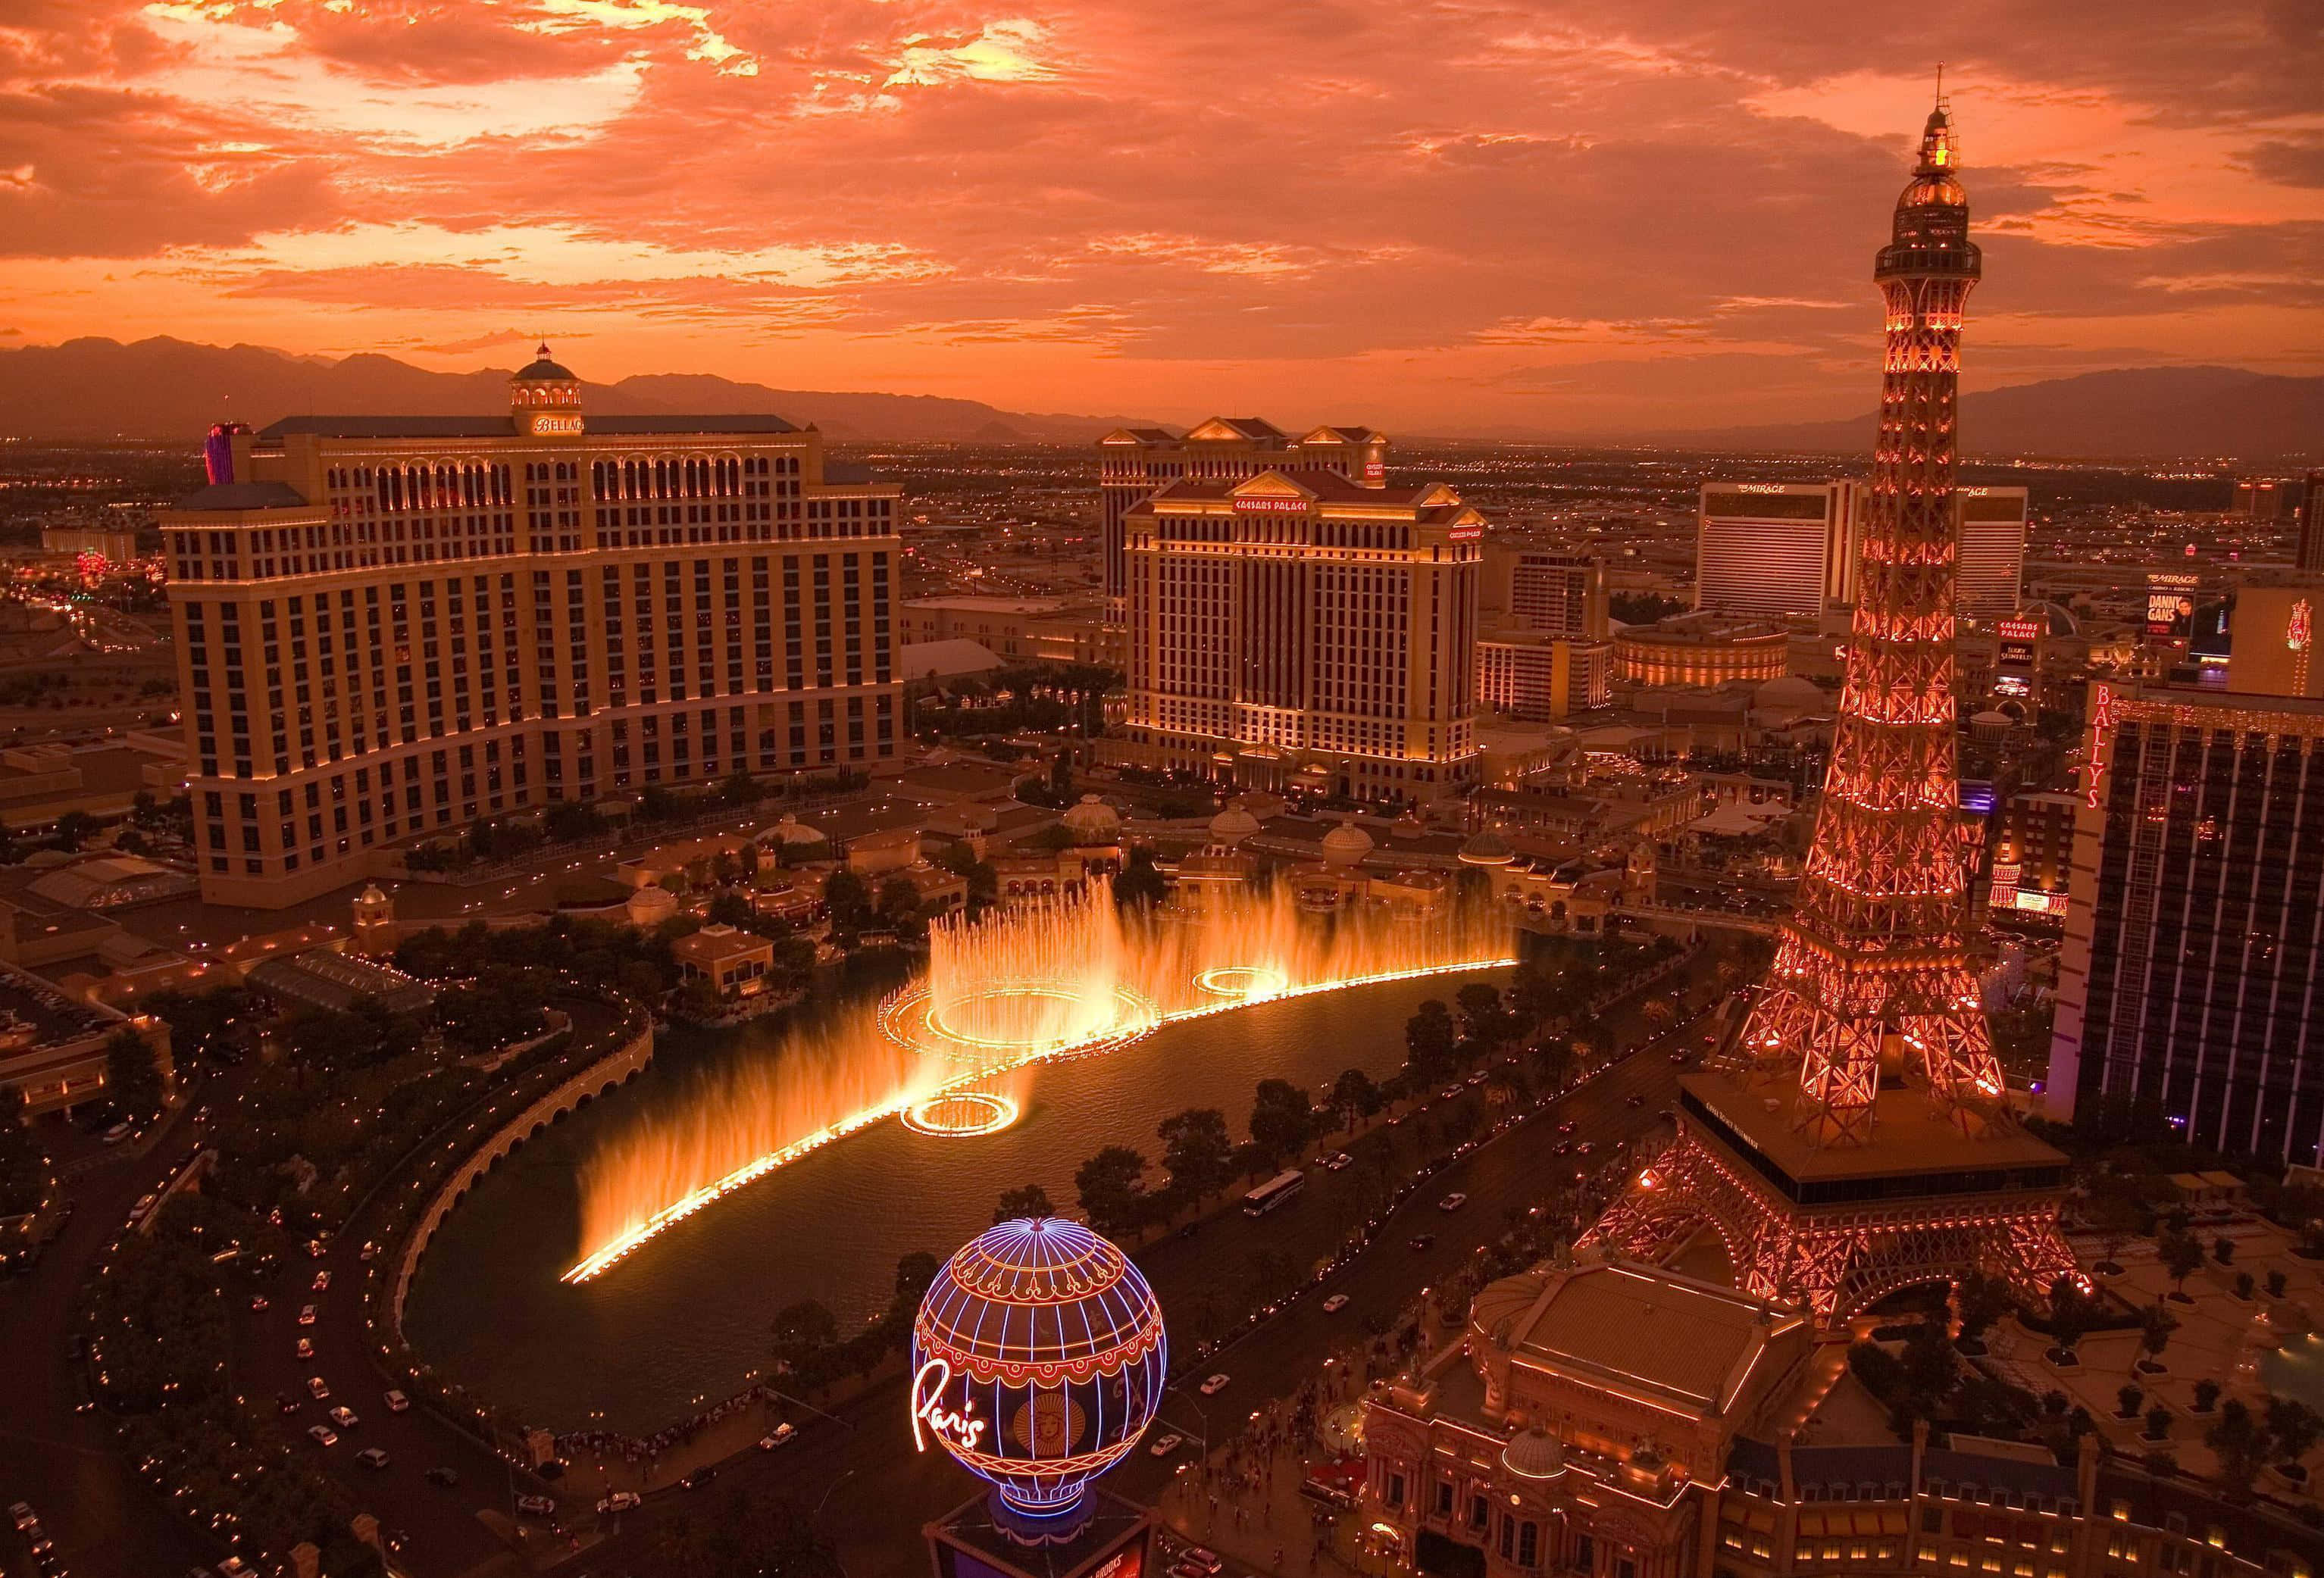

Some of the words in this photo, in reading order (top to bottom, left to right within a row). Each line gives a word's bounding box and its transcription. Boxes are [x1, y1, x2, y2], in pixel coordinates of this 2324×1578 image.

[534, 417, 583, 432] BELLAG
[1741, 483, 1784, 494] MIRAGE
[1236, 501, 1271, 510] CAESARS
[1274, 502, 1307, 511] PALACE
[2152, 574, 2198, 584] MIRAGE
[2148, 595, 2182, 609] DANNY
[2147, 608, 2175, 621] GANS
[2000, 622, 2037, 630] CAESARS
[2001, 630, 2035, 638] PALACE
[911, 1358, 984, 1452] Paris
